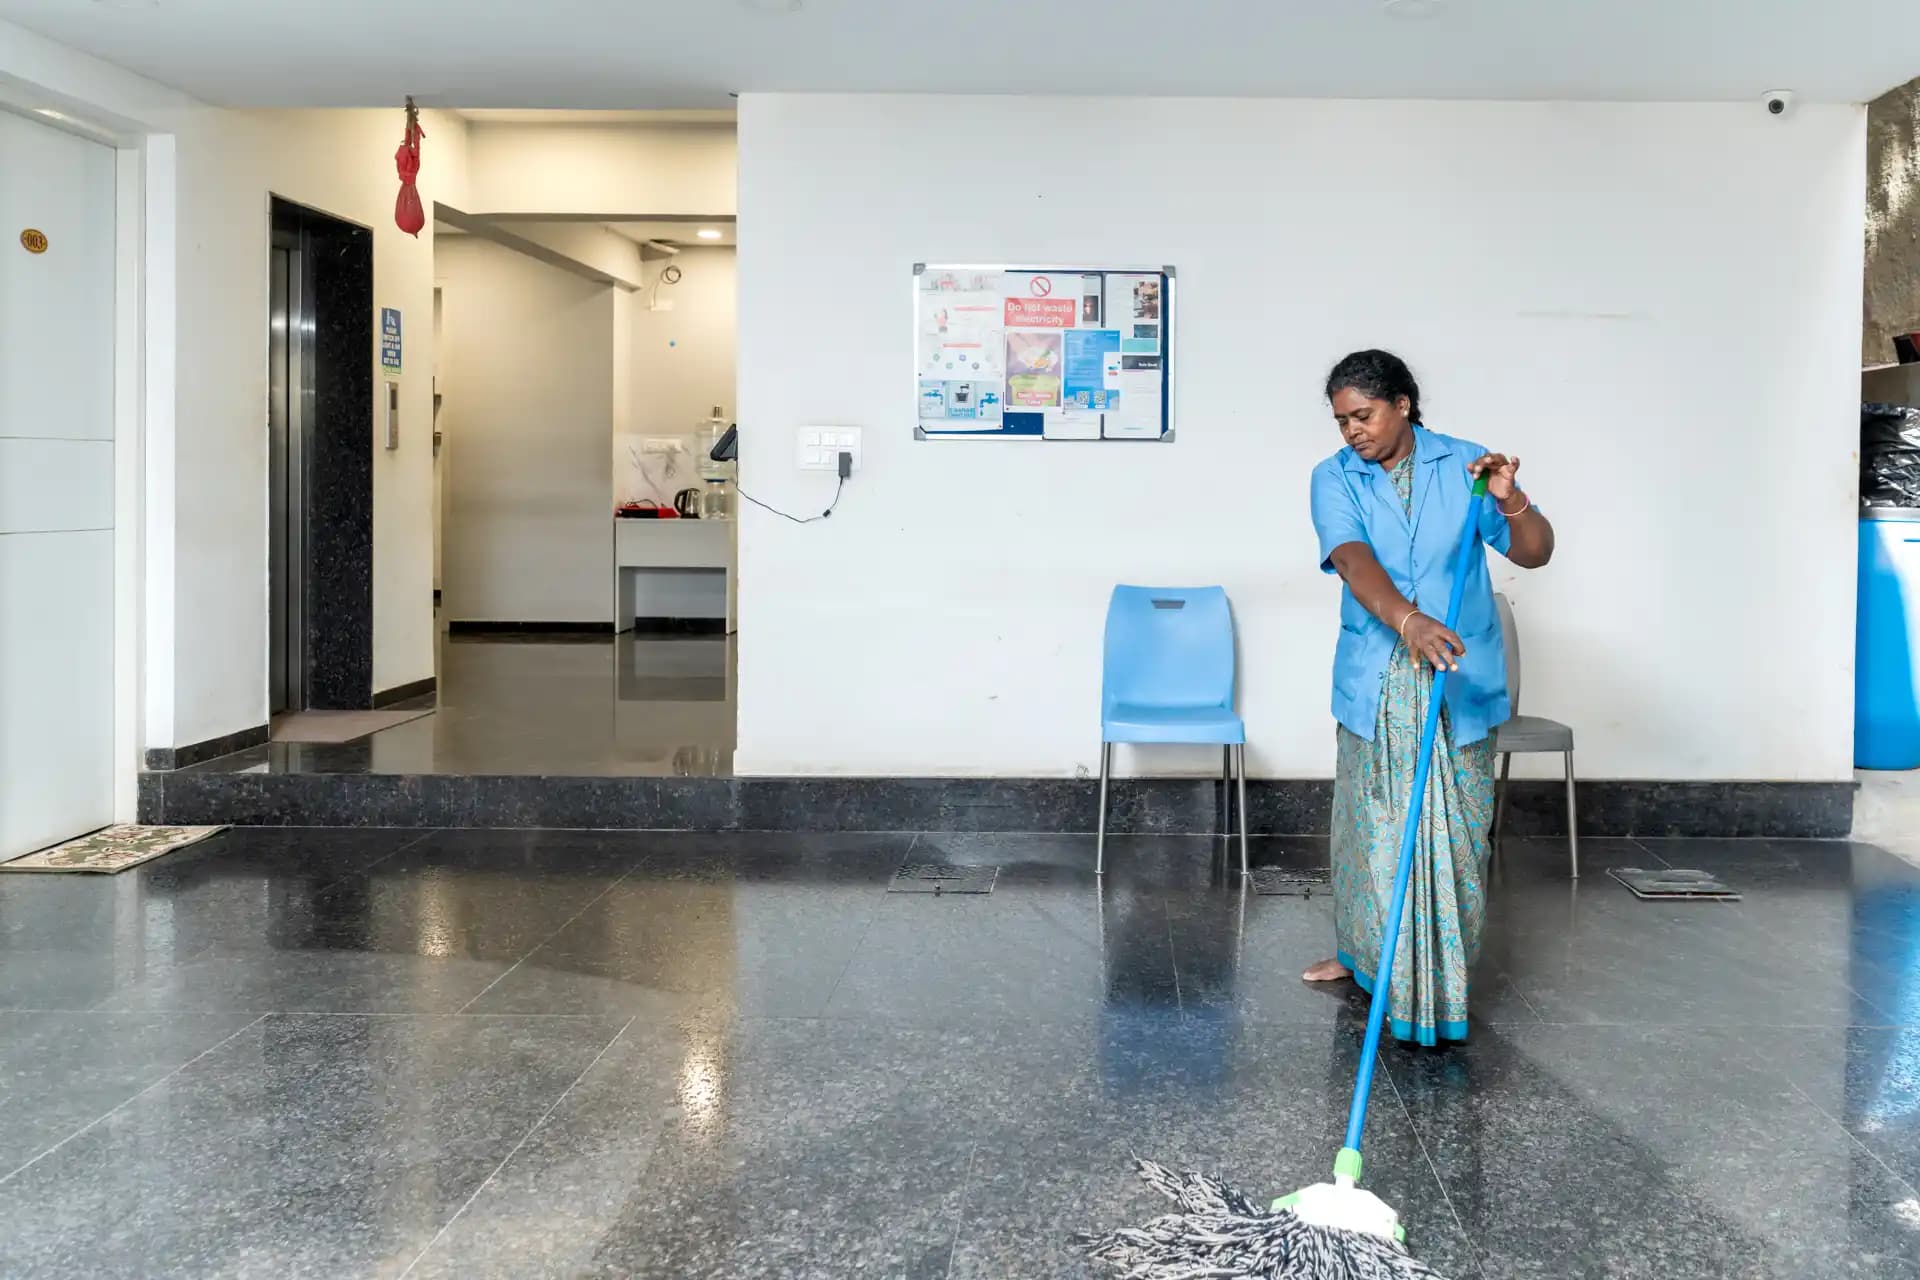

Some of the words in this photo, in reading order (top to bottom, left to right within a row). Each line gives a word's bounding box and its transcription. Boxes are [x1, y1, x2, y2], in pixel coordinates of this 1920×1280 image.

[27, 231, 43, 249] 003
[1008, 302, 1021, 311] Do
[1043, 304, 1072, 312] waste
[1015, 315, 1064, 326] electricity
